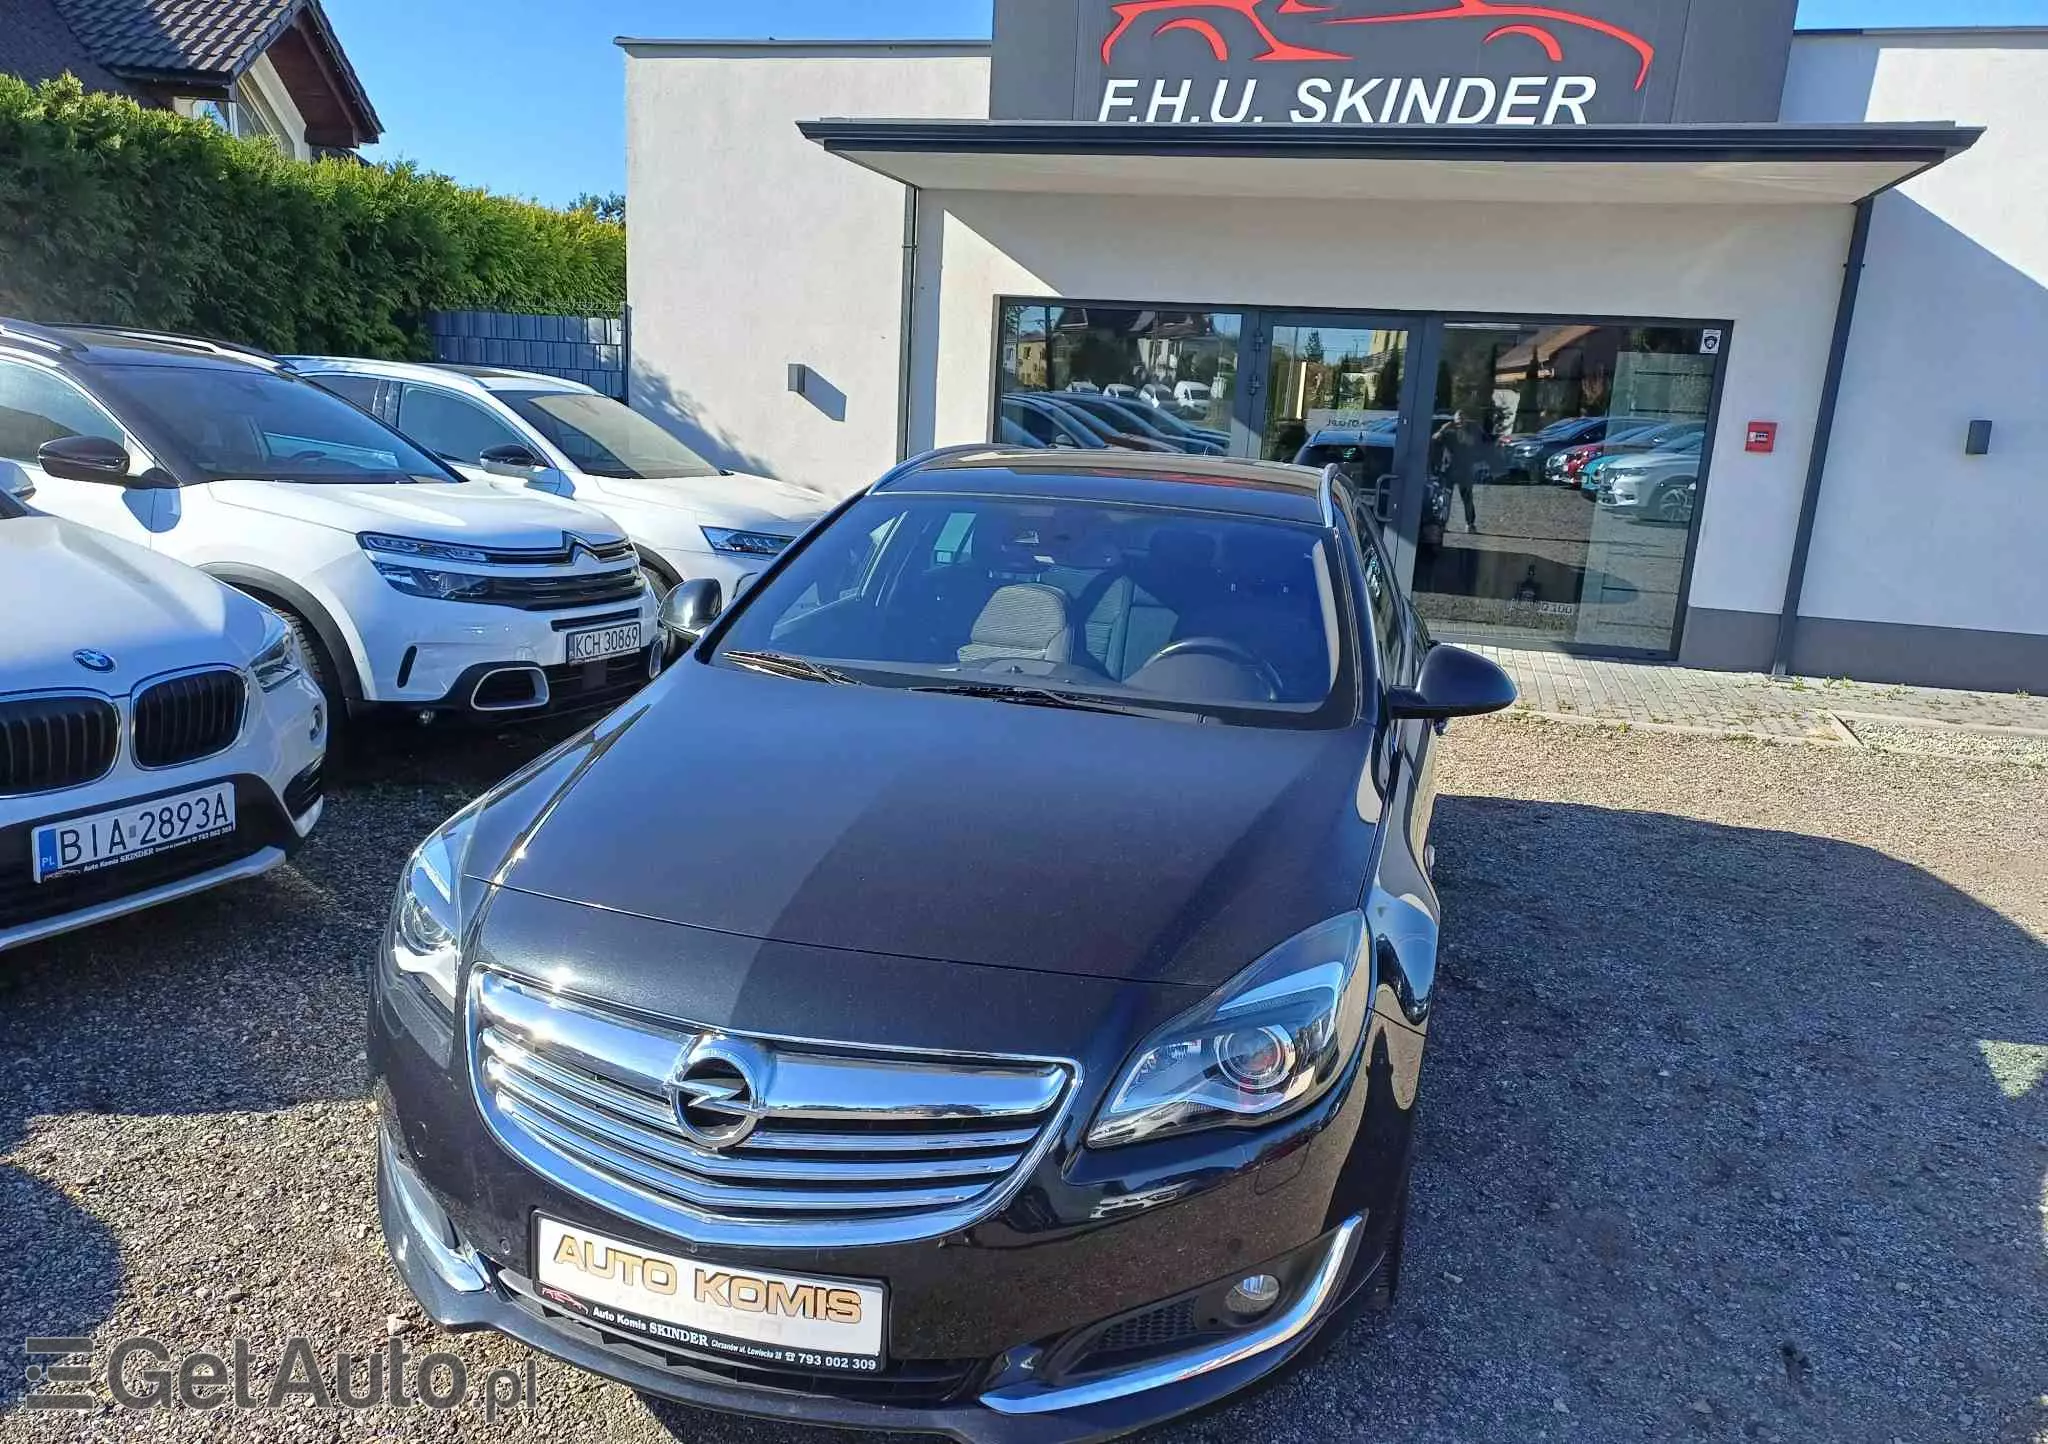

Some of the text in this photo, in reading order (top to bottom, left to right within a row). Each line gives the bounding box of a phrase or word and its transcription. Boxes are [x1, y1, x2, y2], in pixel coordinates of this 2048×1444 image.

[1098, 76, 1597, 125] F.H.U. SKINDER
[575, 626, 638, 657] KCH 30869
[60, 792, 228, 865] BIA 2893A
[42, 855, 55, 867] PL
[553, 1234, 861, 1325] AUTO KOMIS
[593, 1306, 615, 1321] Auto
[617, 1313, 647, 1331] Komis
[649, 1322, 709, 1347] SKINDER
[798, 1353, 822, 1366] 793
[825, 1356, 849, 1368] 002
[852, 1357, 877, 1370] 309
